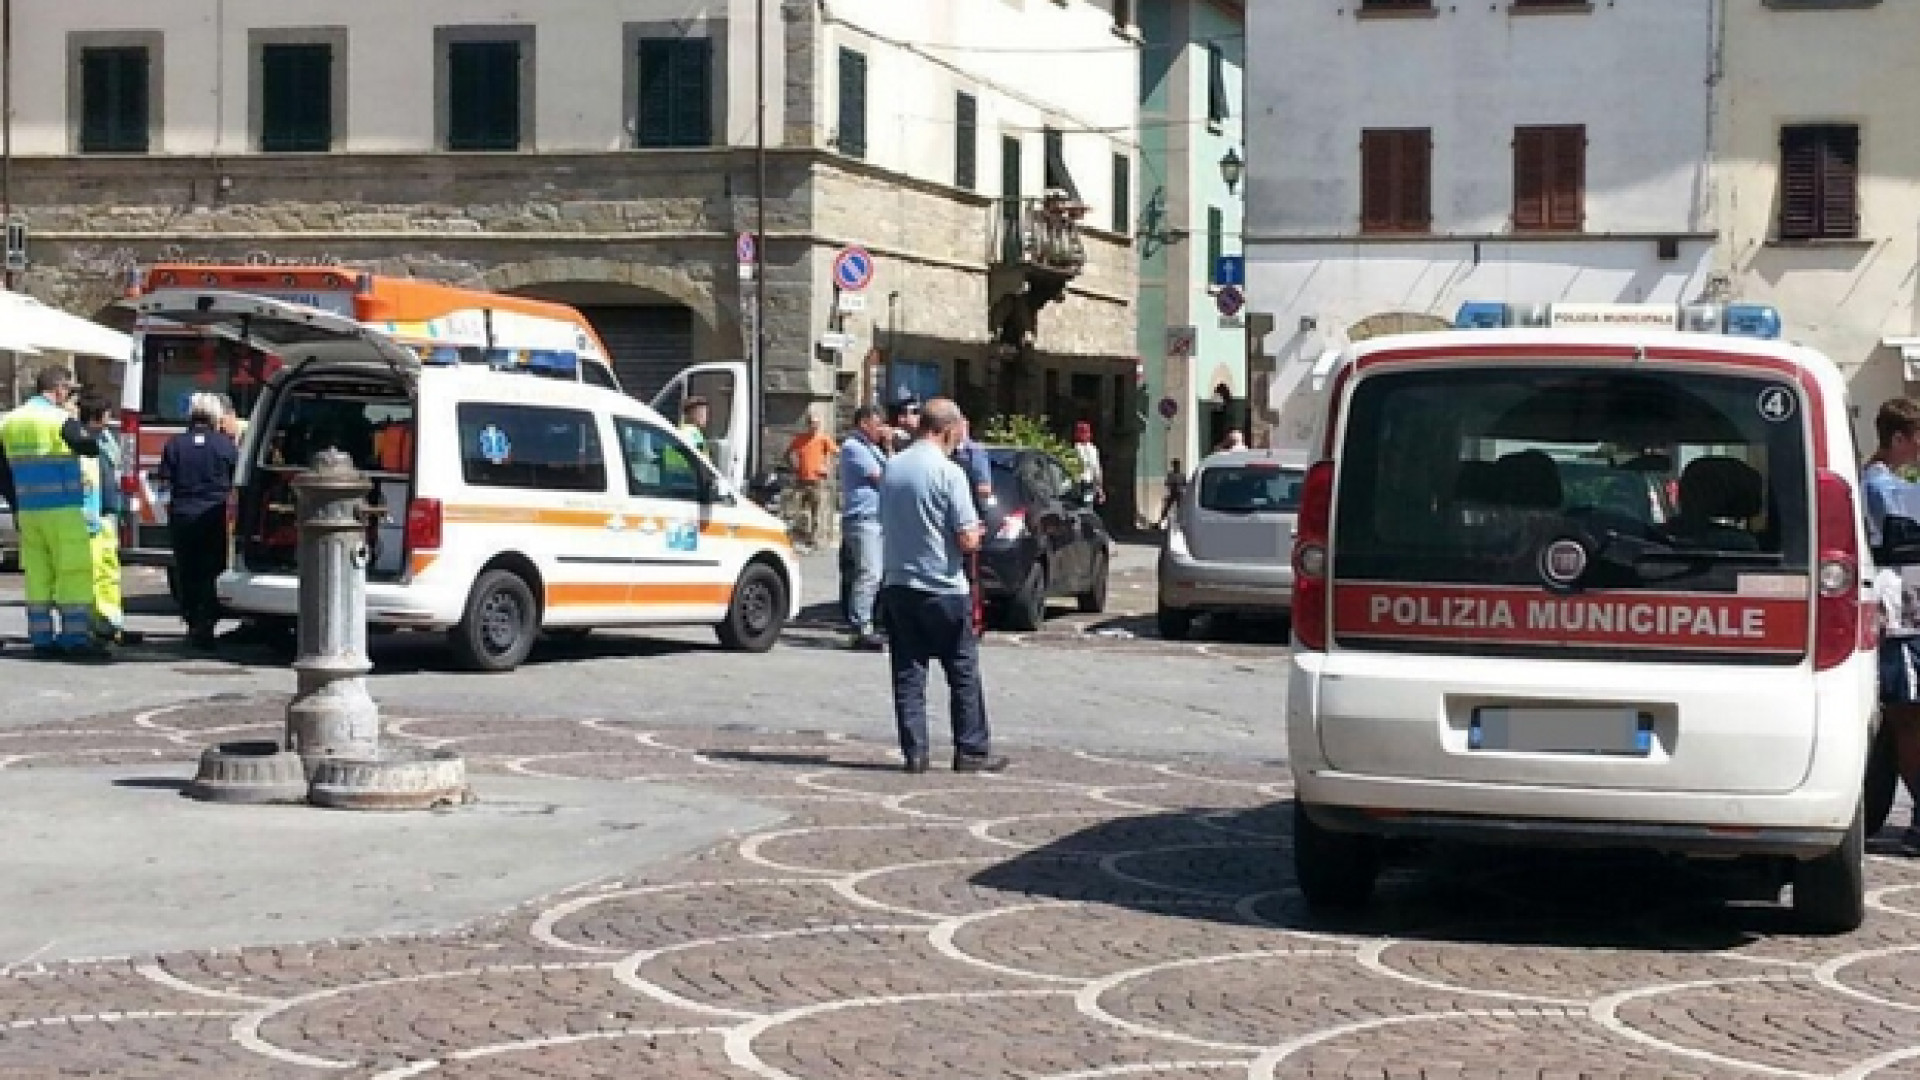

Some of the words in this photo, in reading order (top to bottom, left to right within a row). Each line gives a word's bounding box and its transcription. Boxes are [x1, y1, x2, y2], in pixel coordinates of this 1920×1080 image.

[1554, 312, 1599, 323] POLIZIA
[1603, 312, 1673, 325] MUNICIPALE
[1765, 392, 1784, 415] 4
[1369, 594, 1515, 628] POLIZIA
[1528, 600, 1766, 638] MUNICIPALE
